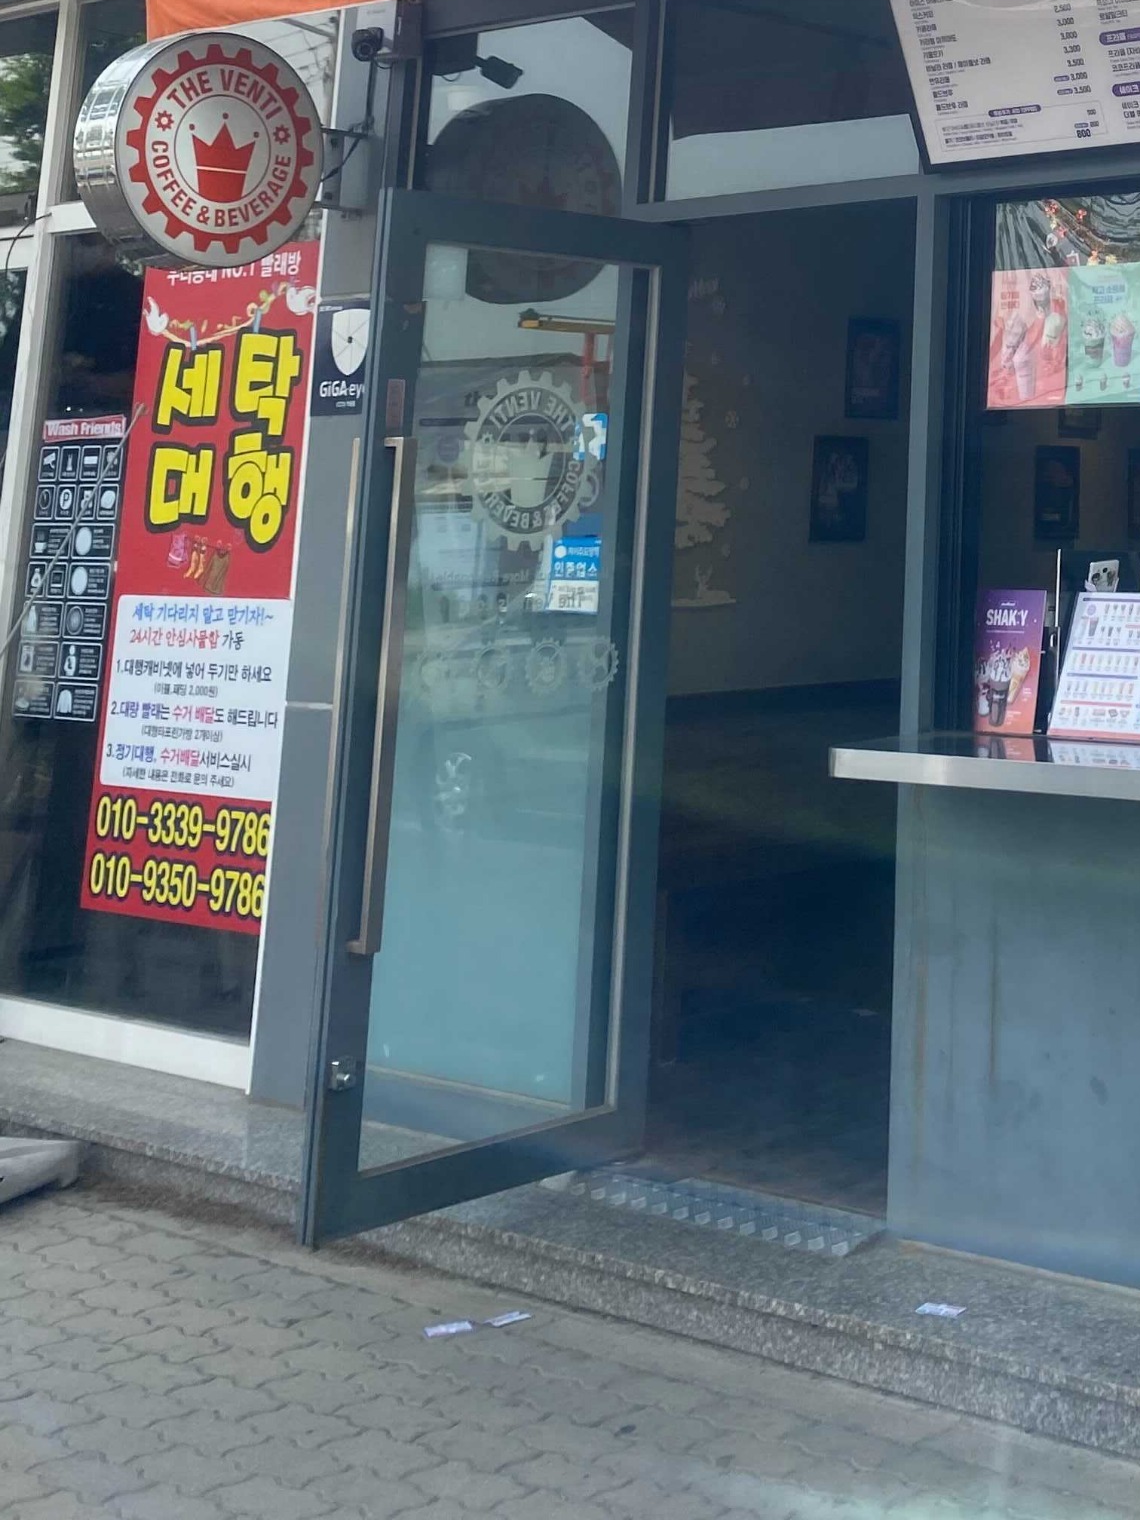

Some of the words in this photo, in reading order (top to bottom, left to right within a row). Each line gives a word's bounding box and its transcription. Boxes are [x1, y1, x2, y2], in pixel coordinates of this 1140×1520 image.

[167, 71, 213, 109] THE
[220, 69, 283, 120] VENTI
[152, 141, 197, 216] COFFEE
[196, 205, 210, 225] &
[215, 155, 291, 227] BEVERAGE
[156, 333, 301, 435] 세탁
[47, 422, 78, 436] Wash
[150, 432, 290, 543] 대행
[158, 604, 198, 622] 기다리지
[129, 628, 163, 646] 24시간
[222, 631, 244, 651] 가동
[208, 663, 238, 681] 두기만
[242, 665, 272, 682] 하세요
[172, 705, 192, 722] 수거
[227, 708, 278, 728] 해드립니다
[96, 796, 270, 857] 010-3339-9786
[90, 853, 265, 918] 010-9350-9786
